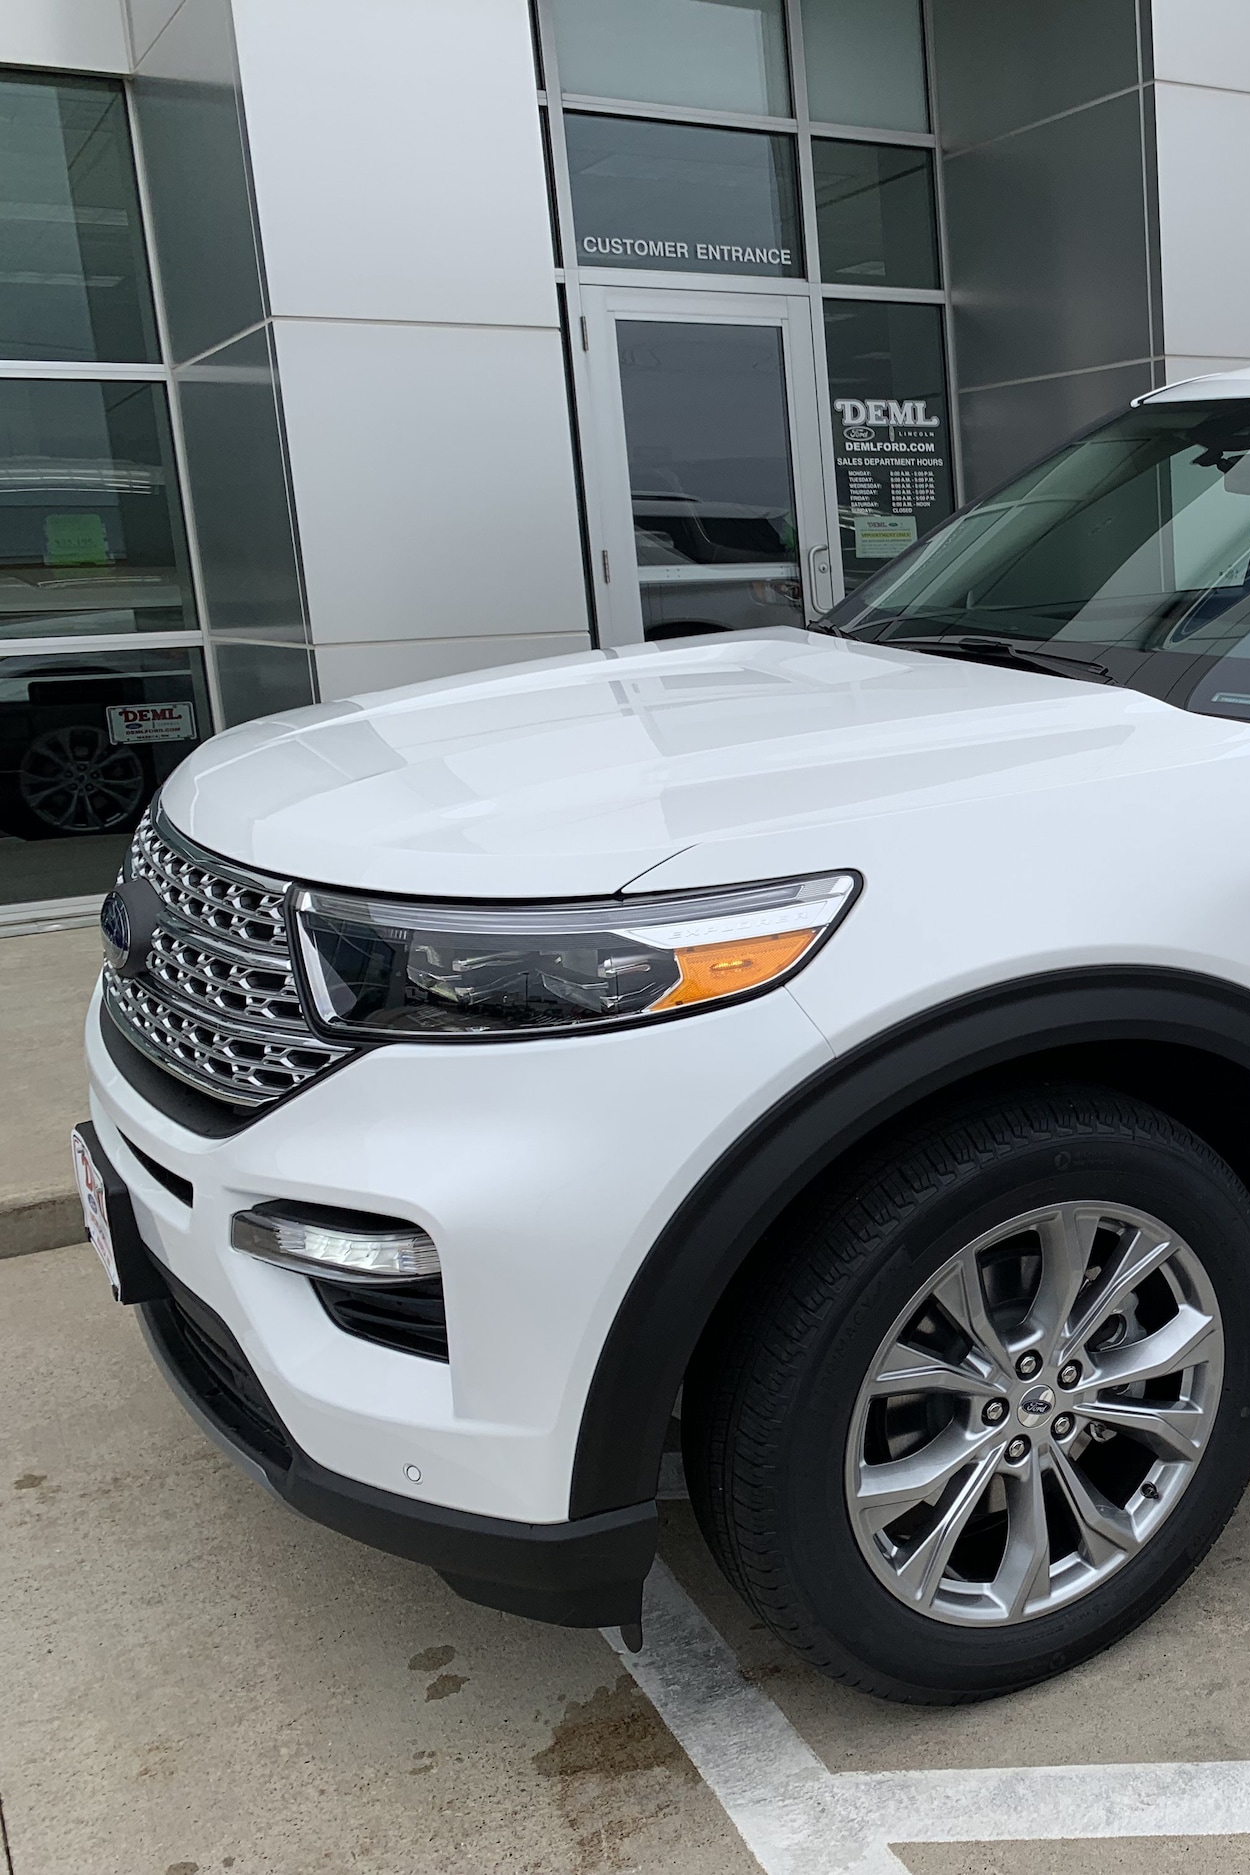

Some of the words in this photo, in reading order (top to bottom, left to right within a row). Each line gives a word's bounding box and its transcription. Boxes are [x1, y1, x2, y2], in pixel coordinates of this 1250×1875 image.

[583, 236, 689, 258] CUSTOMER
[696, 244, 792, 265] ENTRANCE
[834, 399, 940, 427] DEML
[845, 442, 935, 452] DEMLFORD.COM
[837, 458, 863, 466] SALES
[864, 458, 916, 466] DEPARTMENT
[917, 459, 943, 467] HOURS
[119, 708, 182, 722] DEML
[1026, 1402, 1047, 1413] Ford
